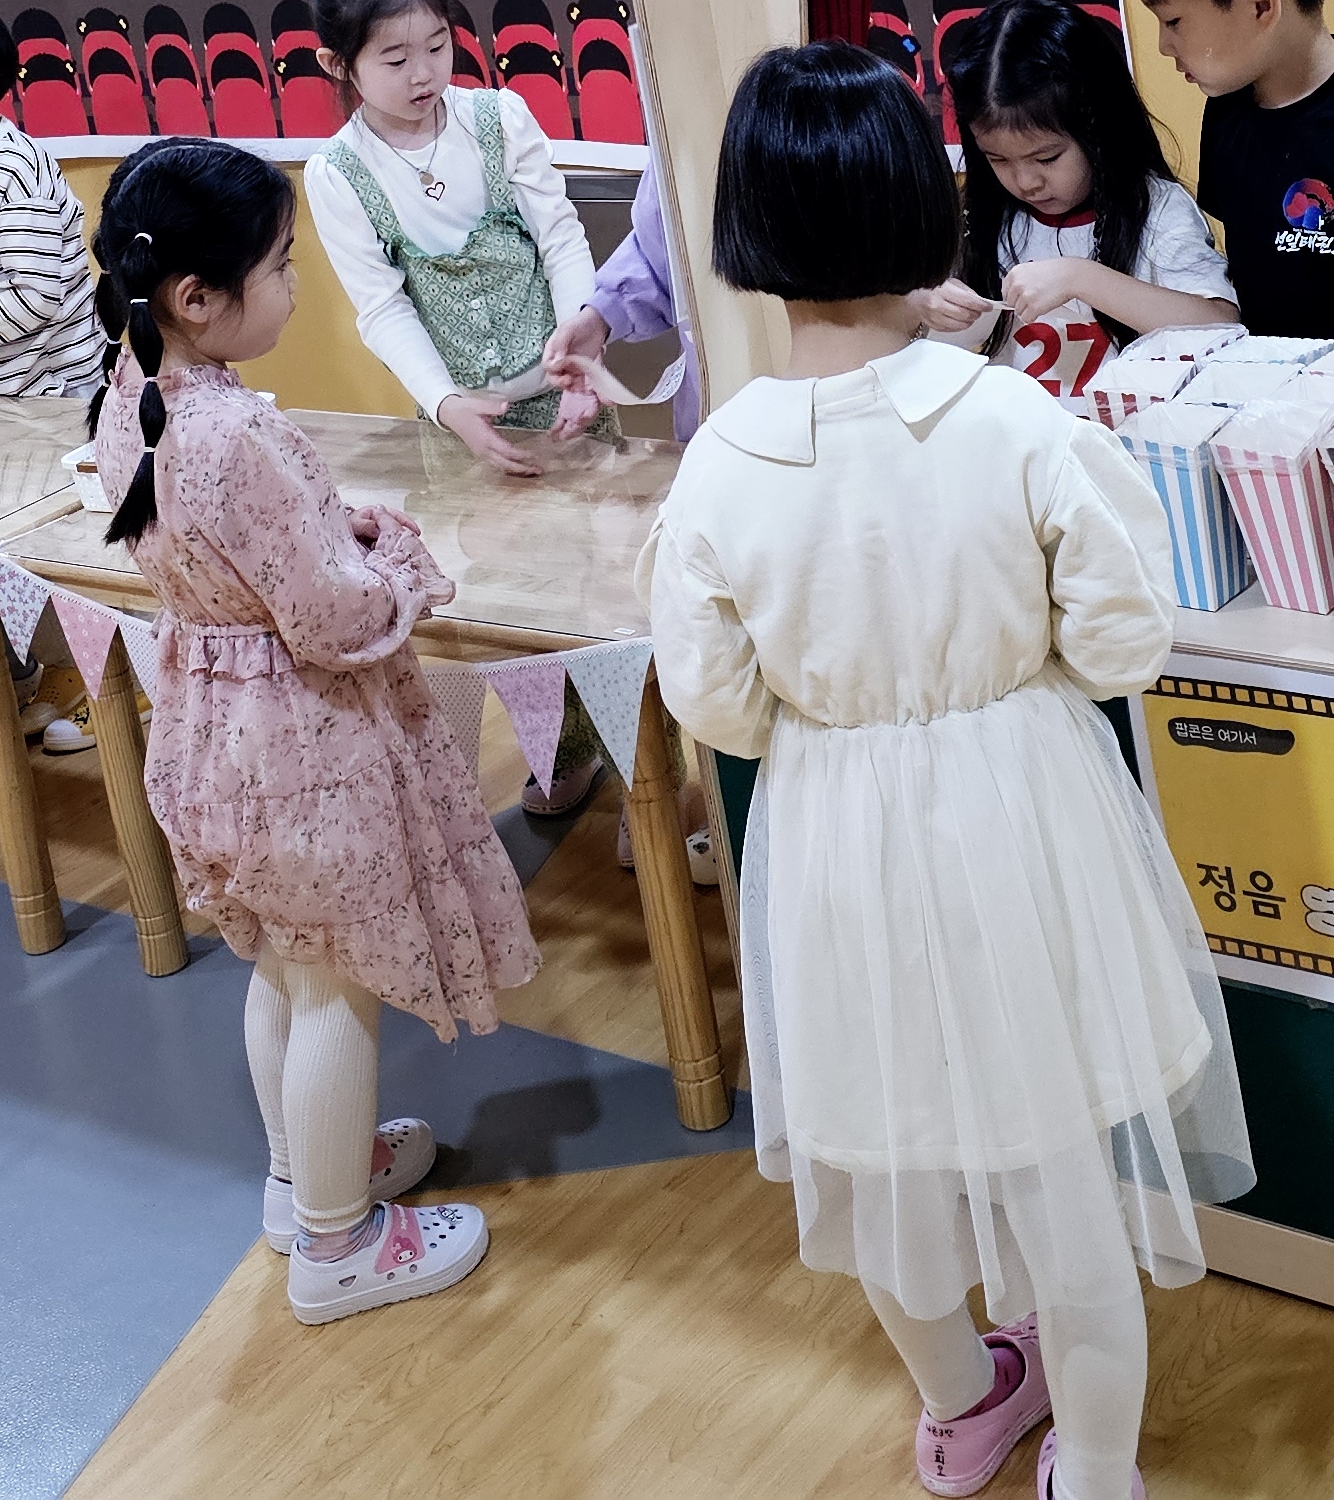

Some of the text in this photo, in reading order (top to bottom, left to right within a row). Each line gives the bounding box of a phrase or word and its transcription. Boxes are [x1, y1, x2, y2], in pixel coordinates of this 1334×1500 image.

[1013, 322, 1111, 397] 27
[1175, 722, 1258, 746] 팝콘은 여기서
[1196, 862, 1287, 921] 정음
